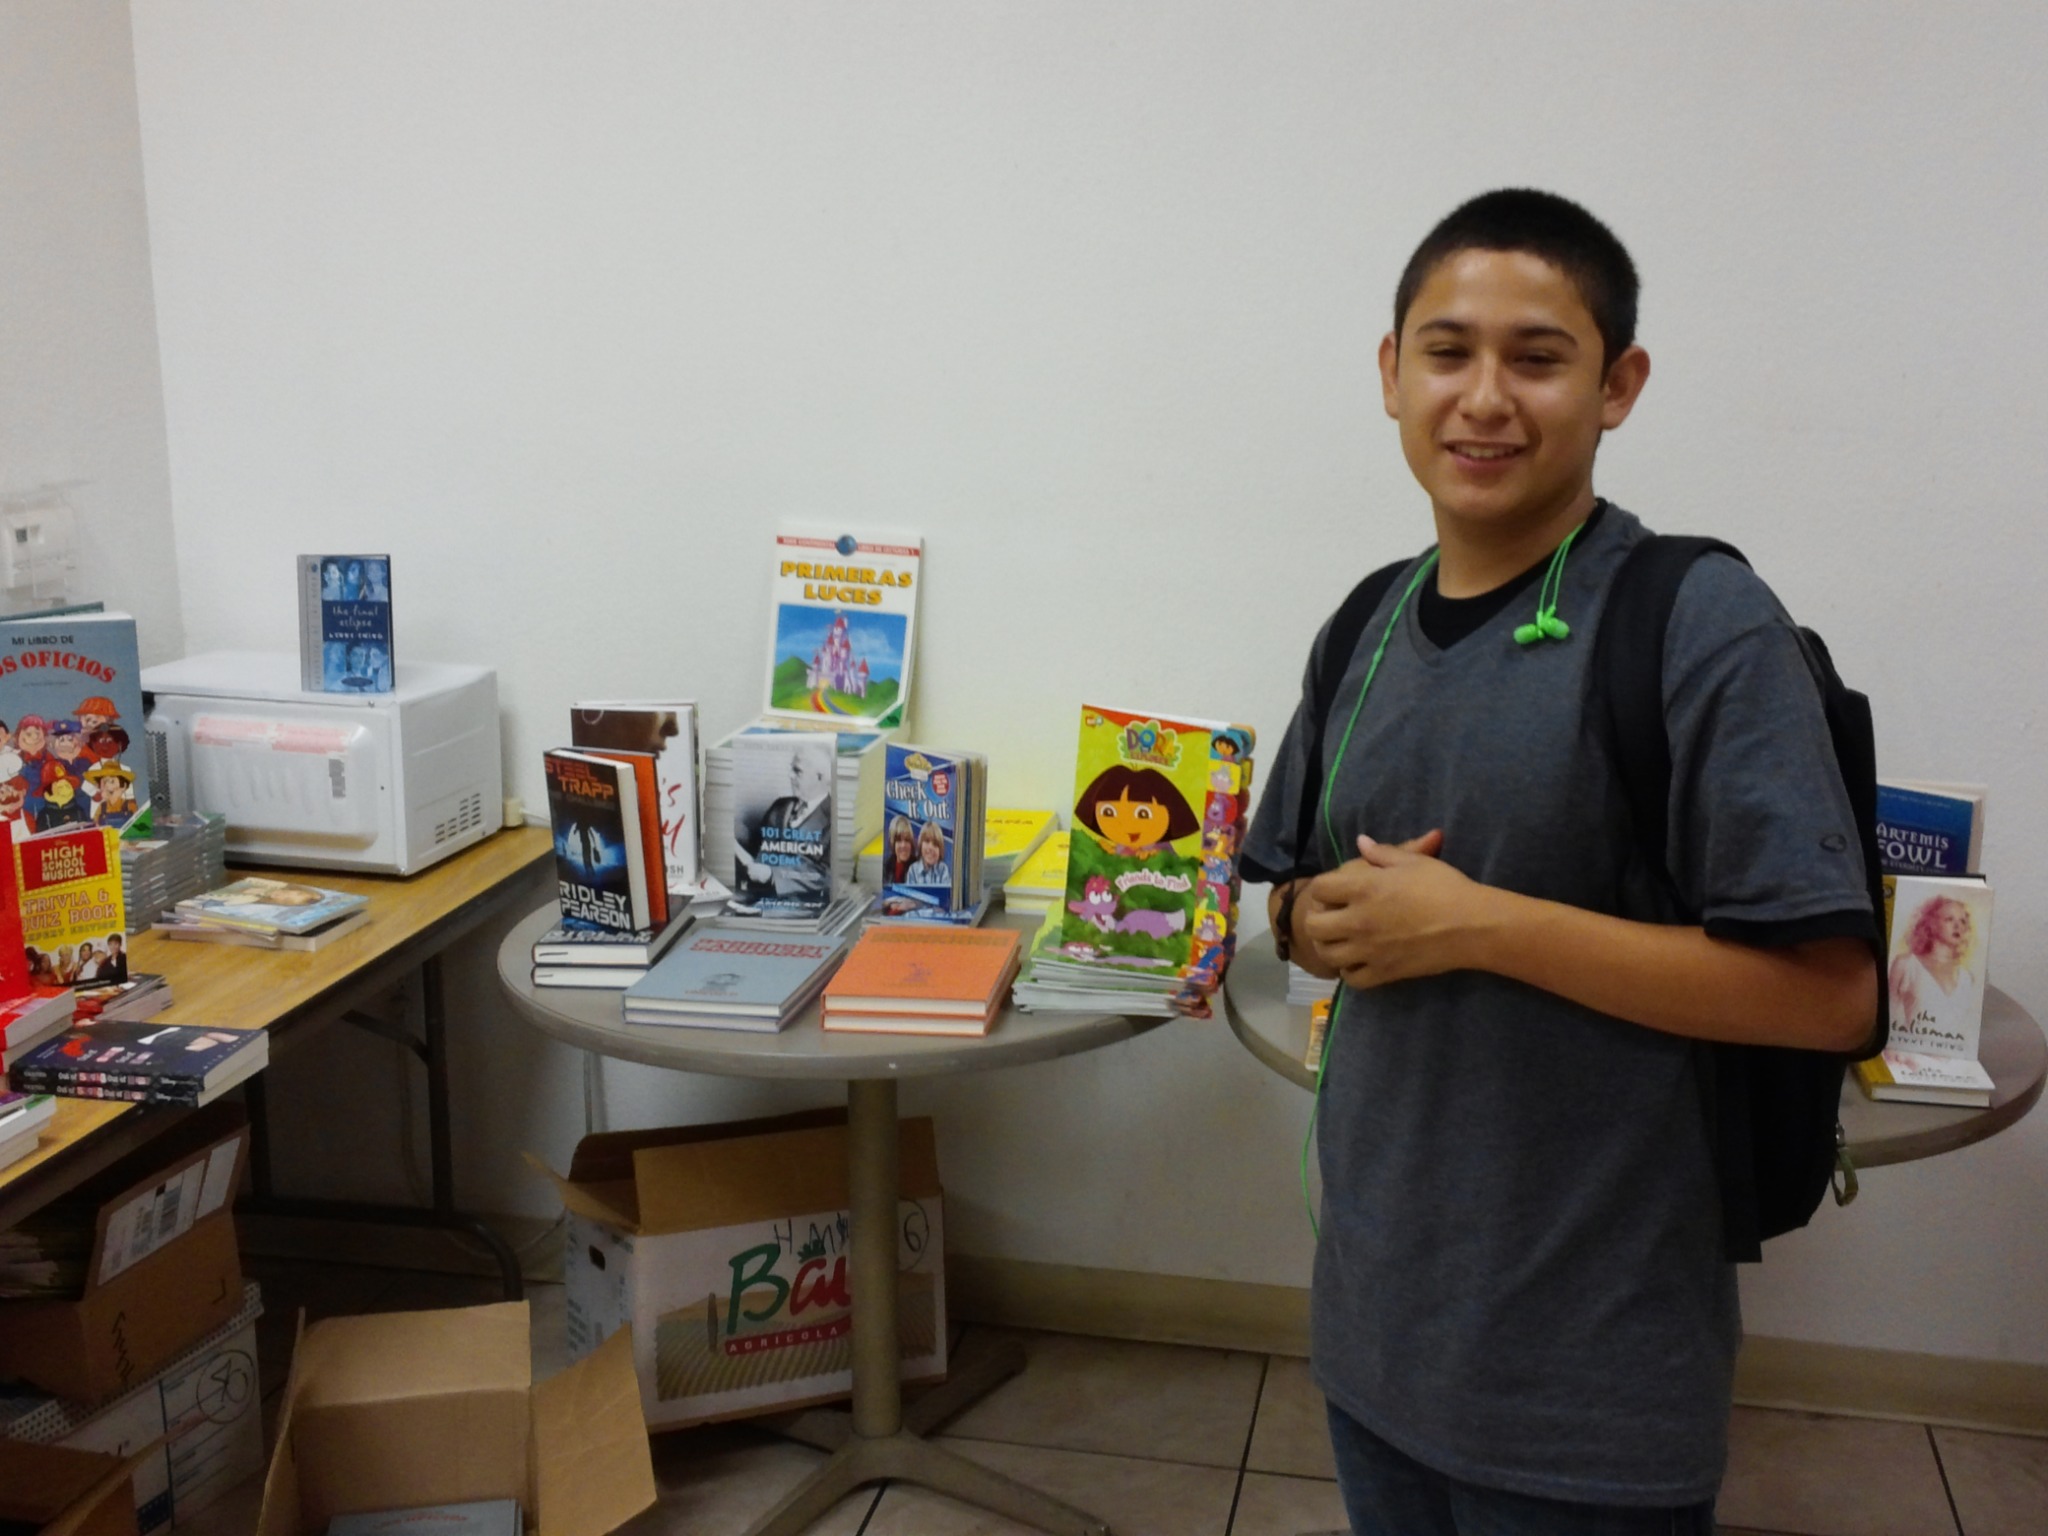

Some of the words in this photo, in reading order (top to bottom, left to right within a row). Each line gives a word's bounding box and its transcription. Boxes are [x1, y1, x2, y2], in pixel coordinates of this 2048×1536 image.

[781, 561, 913, 587] PRIMERAS
[804, 583, 882, 605] LUCES
[12, 637, 25, 645] MI
[28, 635, 57, 645] LIBRO
[60, 635, 74, 644] DE
[20, 650, 116, 683] OFICIOS
[1126, 728, 1175, 757] DORA
[545, 757, 597, 781] STEEL
[558, 776, 614, 799] TRAPP
[886, 780, 927, 800] Check
[907, 800, 920, 819] It
[923, 801, 951, 820] Out
[760, 827, 780, 839] 101
[783, 828, 822, 842] GREAT
[1876, 822, 1949, 850] ARTEMIS
[41, 844, 85, 862] HIGH
[760, 840, 824, 855] AMERICAN
[42, 858, 86, 873] SCHOOL
[761, 854, 802, 867] POEMS
[42, 867, 87, 882] MUSICAL
[23, 891, 90, 915] TRIVIA
[559, 881, 626, 911] RIDLEY
[69, 903, 118, 924] BOOK
[561, 899, 631, 929] PEARSON
[1917, 1010, 1936, 1023] the
[1891, 1019, 1965, 1041] talisman
[903, 1212, 922, 1253] 6
[729, 1326, 838, 1353] AGRICOLA
